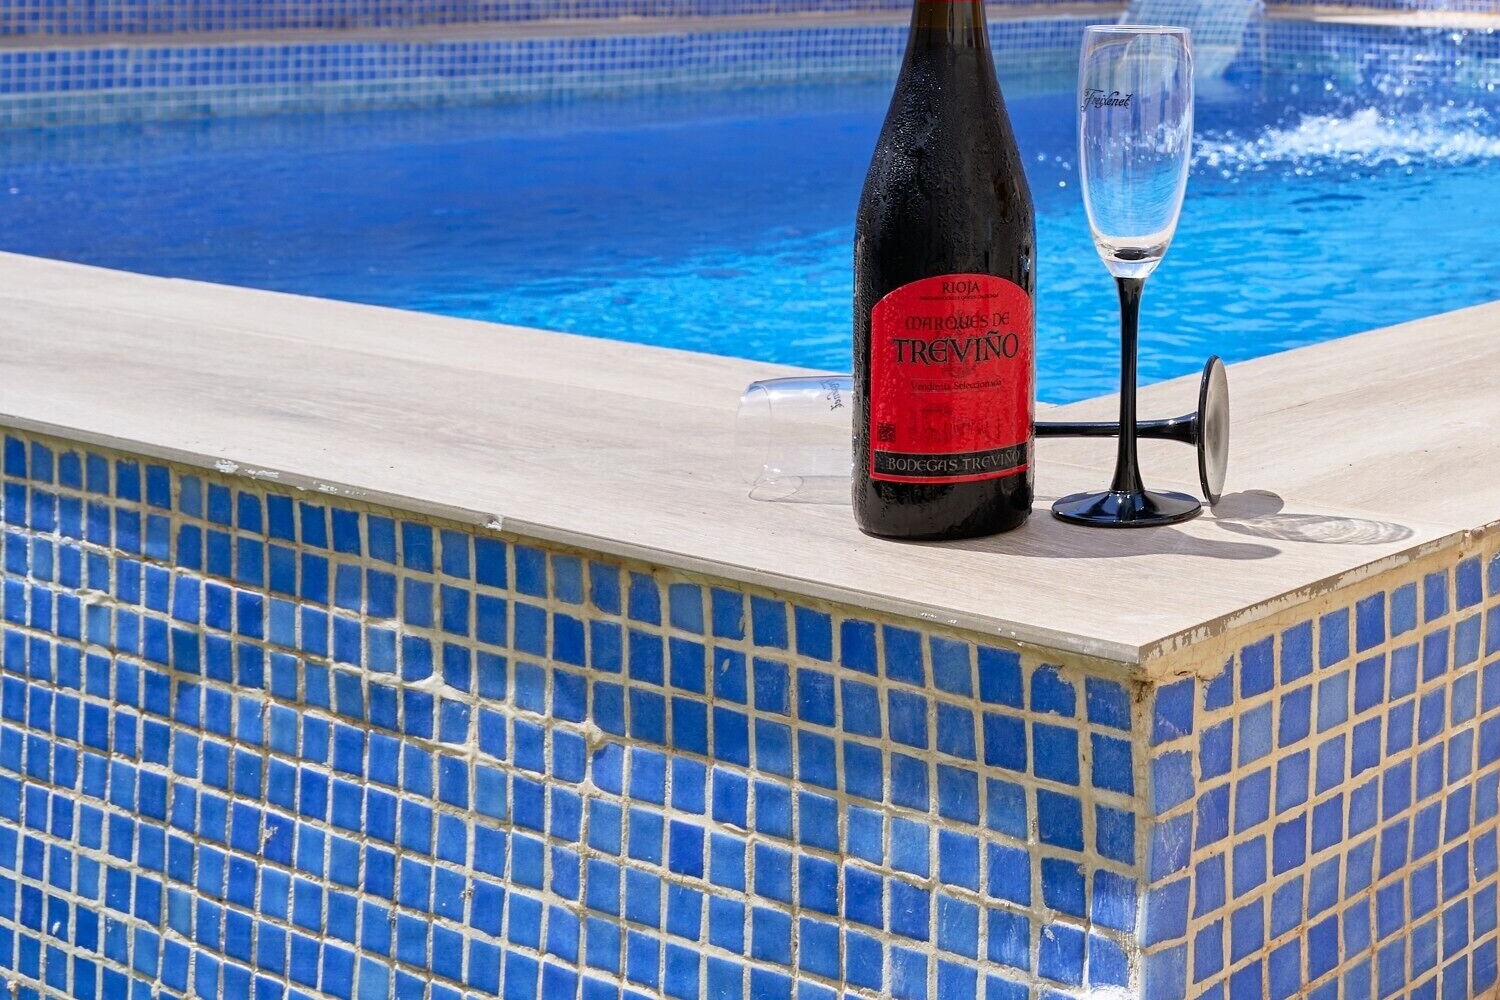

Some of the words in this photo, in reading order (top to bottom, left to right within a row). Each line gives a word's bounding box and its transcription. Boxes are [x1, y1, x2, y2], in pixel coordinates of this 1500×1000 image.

[1081, 88, 1133, 112] Freixenet
[942, 281, 980, 294] RIOJA
[992, 312, 1010, 326] DE
[893, 330, 1019, 365] TREVIÑO
[887, 456, 958, 472] BODEGAS
